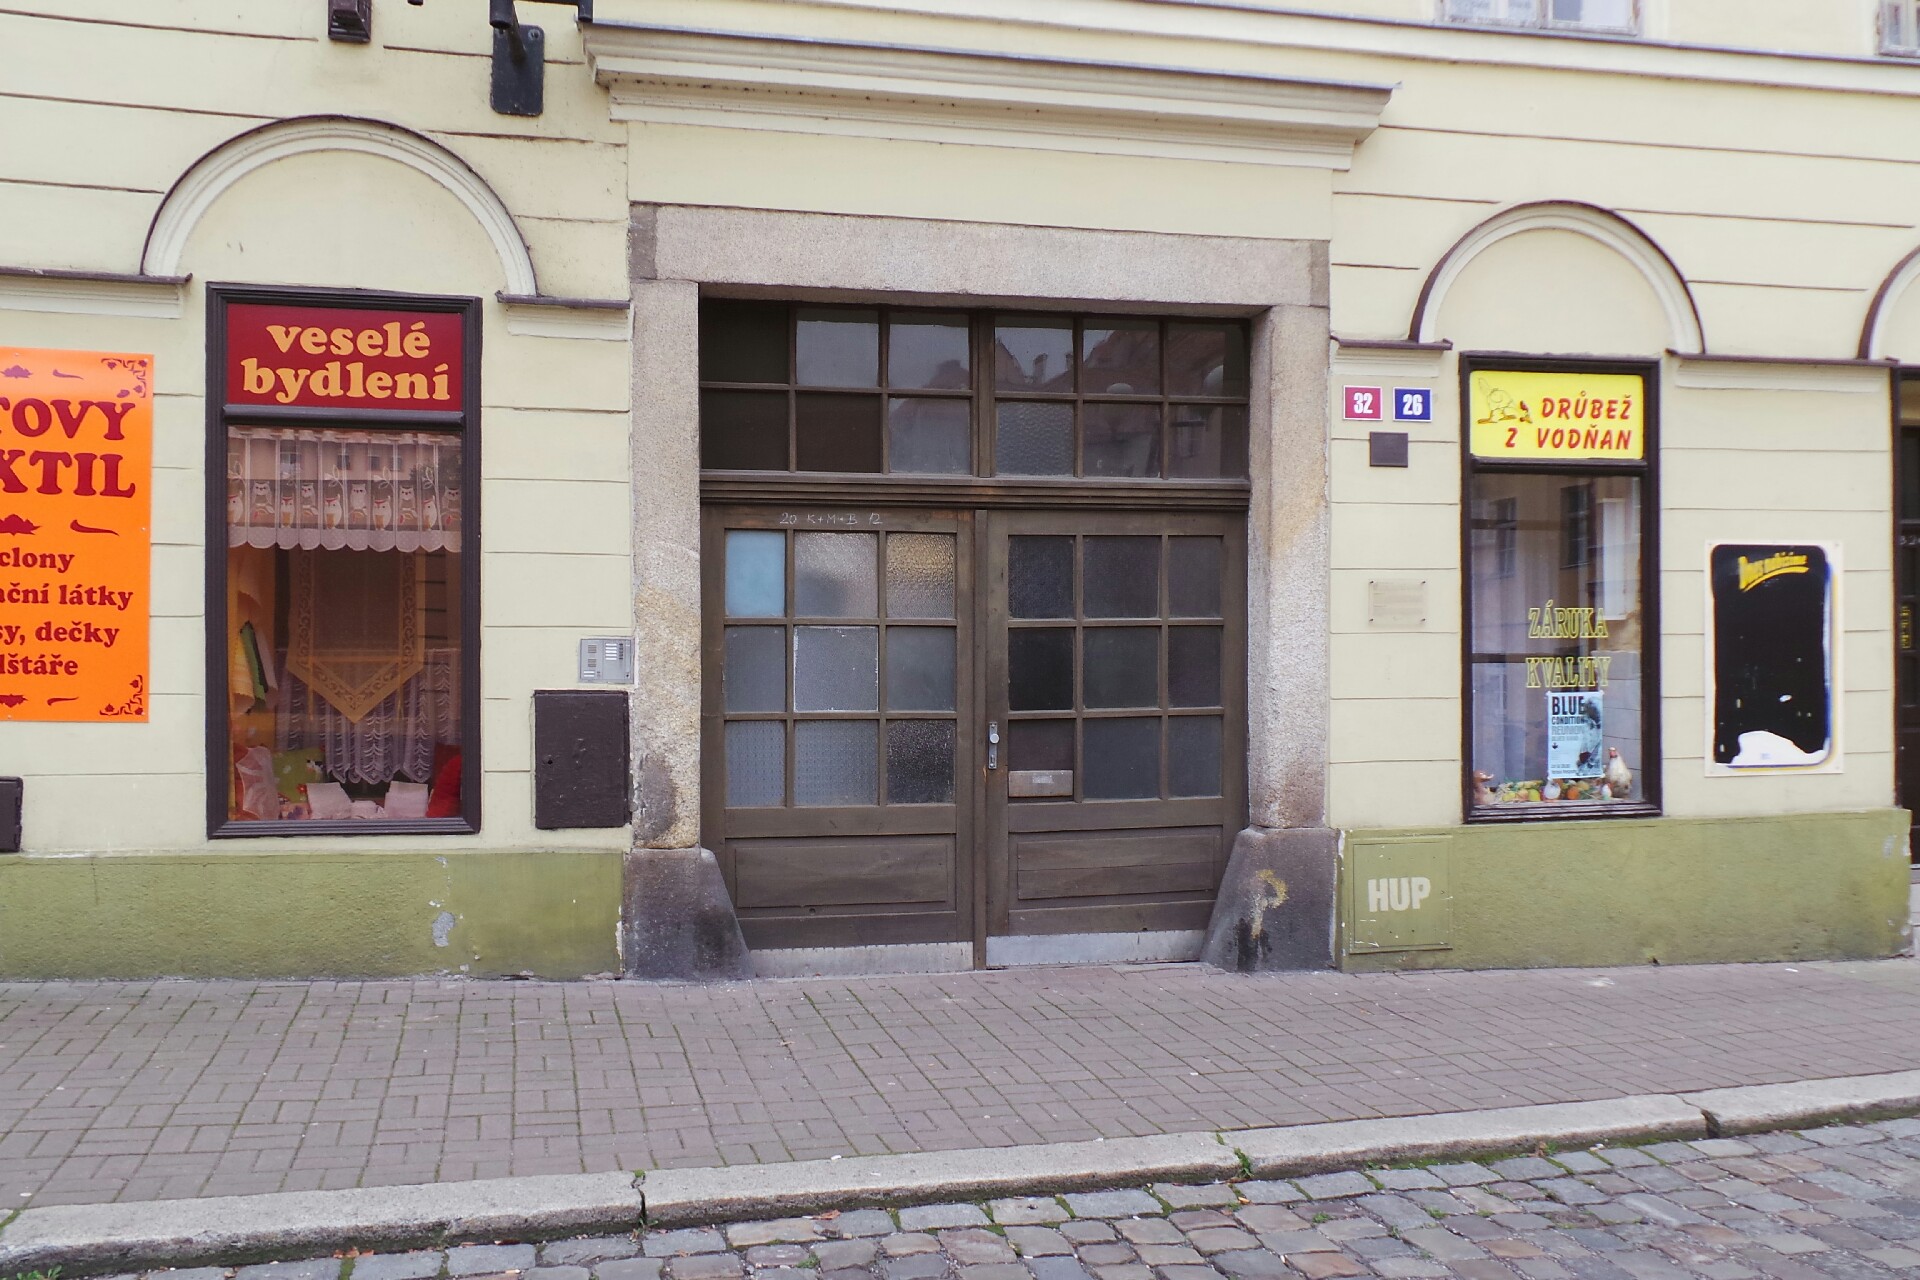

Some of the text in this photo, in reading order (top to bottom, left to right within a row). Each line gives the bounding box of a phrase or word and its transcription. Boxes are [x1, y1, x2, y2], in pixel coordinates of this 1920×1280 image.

[266, 321, 431, 359] veselé
[240, 357, 451, 404] bydlení
[1353, 392, 1374, 414] 32
[1402, 393, 1424, 416] 26
[1541, 390, 1633, 420] DRŮBEŽ
[0, 397, 136, 441] OVY
[1505, 424, 1632, 450] Z VODŇAN
[780, 512, 797, 525] 20
[58, 584, 133, 610] látky
[1528, 599, 1609, 638] ZÁRUKA
[0, 621, 120, 647] y, dečky
[1525, 656, 1611, 688] KVALITY
[1552, 695, 1585, 715] BLUE
[1367, 876, 1431, 912] HUP
